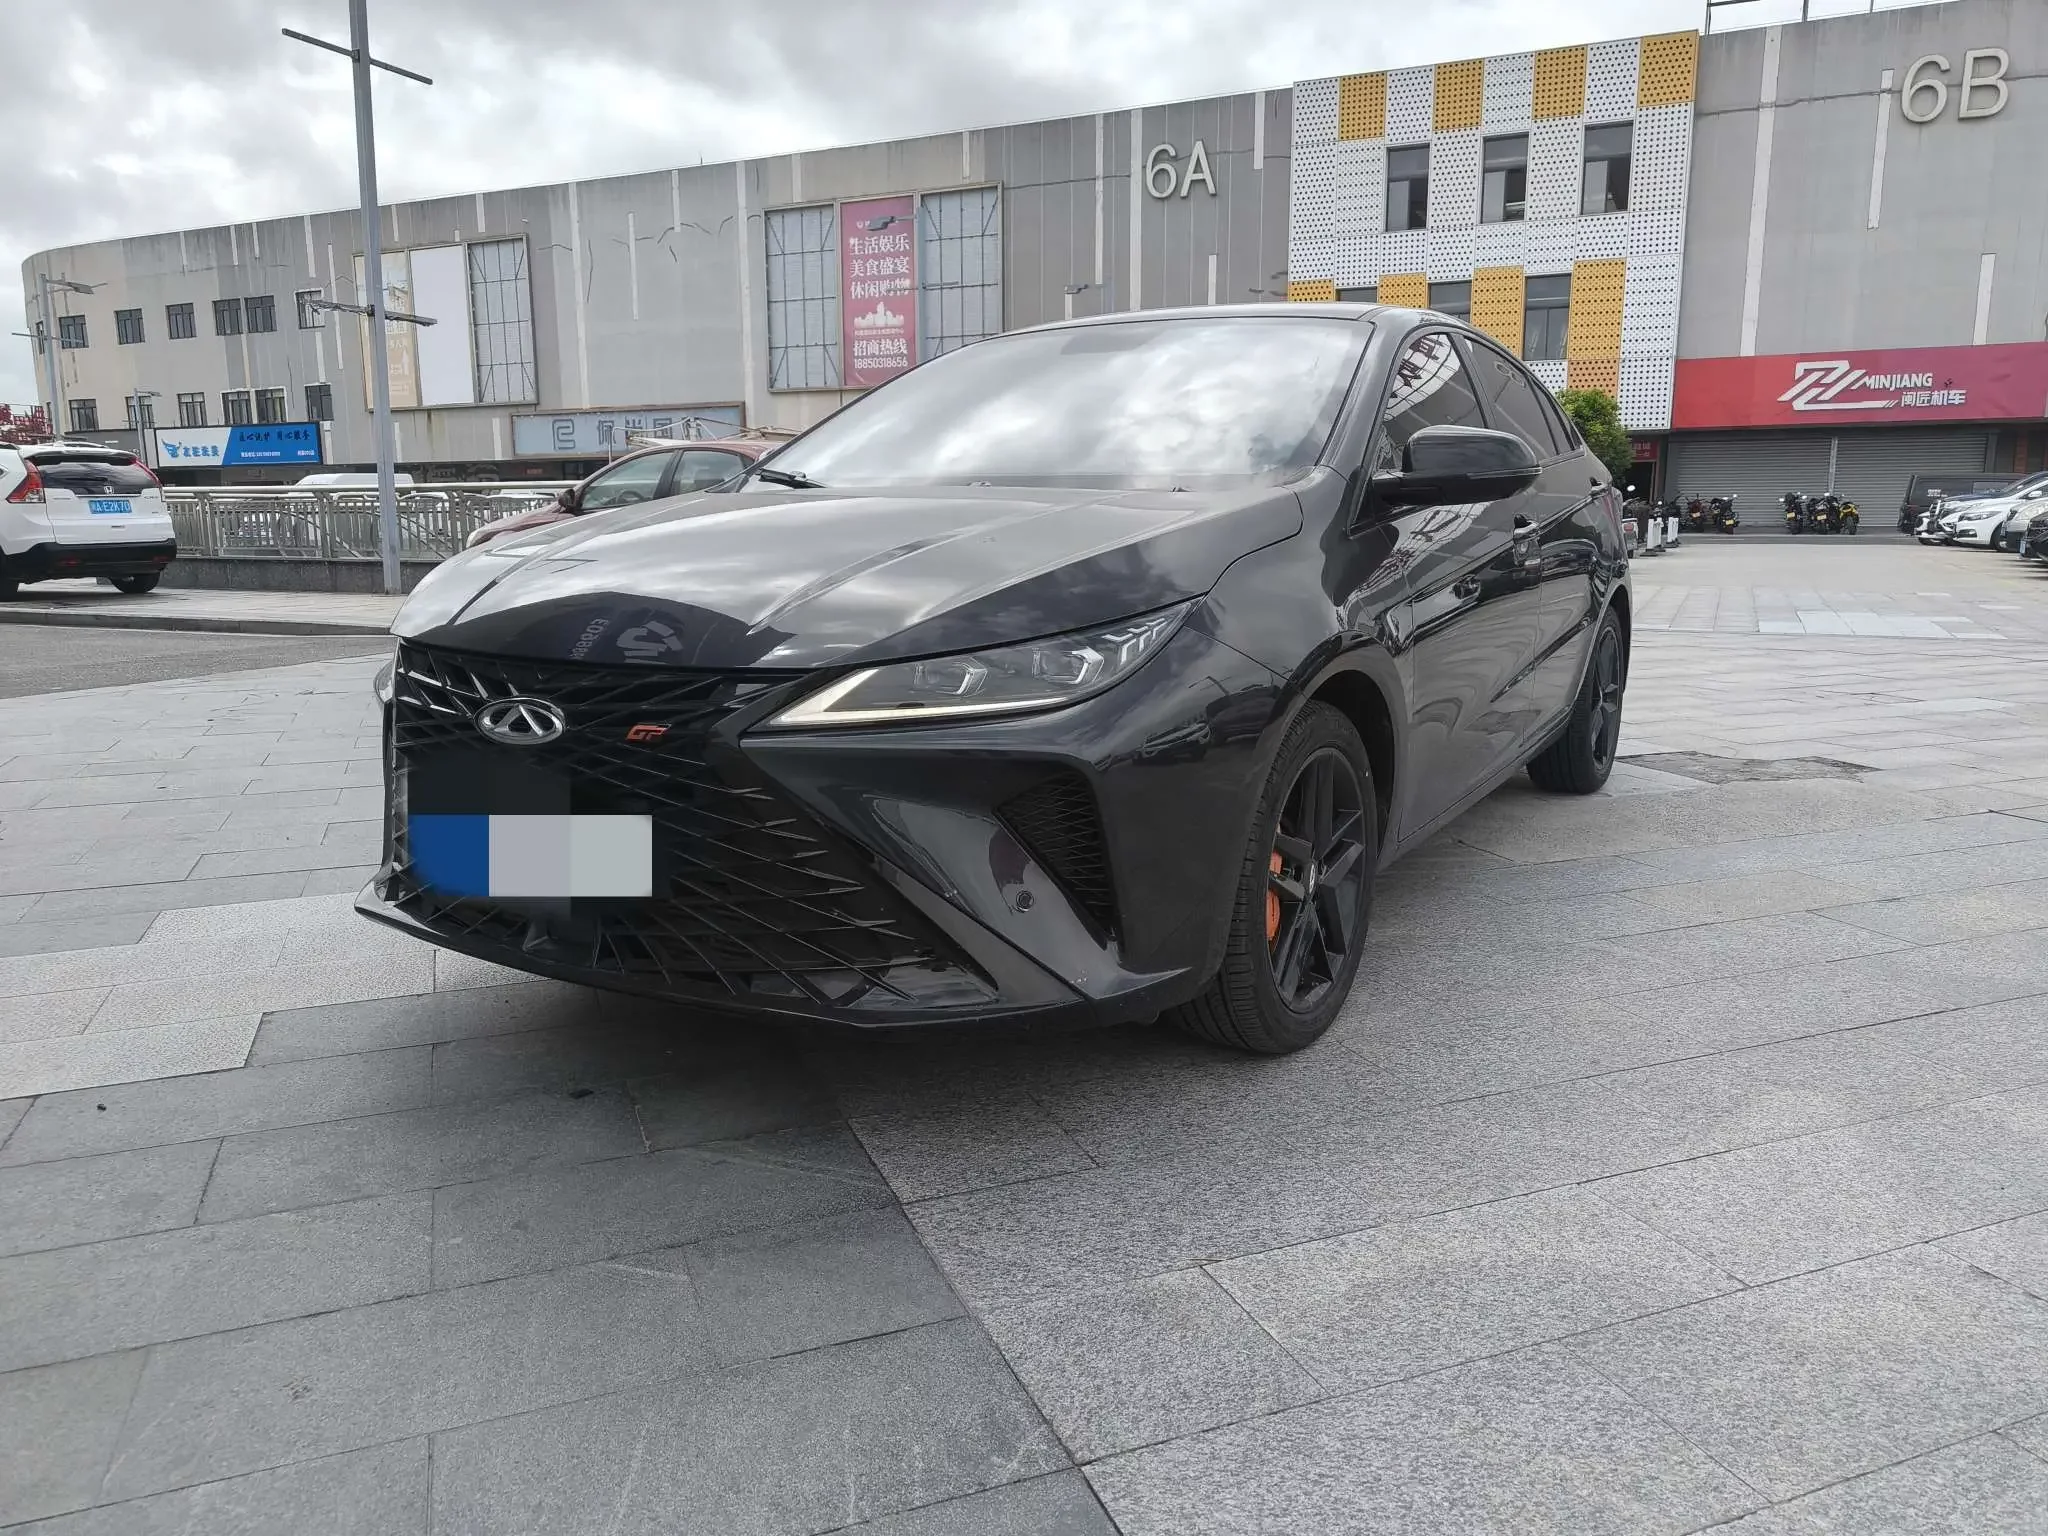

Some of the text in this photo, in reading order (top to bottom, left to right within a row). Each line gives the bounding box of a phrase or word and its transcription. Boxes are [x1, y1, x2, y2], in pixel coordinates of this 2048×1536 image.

[1902, 48, 2009, 122] 6B
[1146, 141, 1216, 198] 6A
[849, 233, 910, 255] 生活娱乐
[849, 256, 910, 278] 美食盛宴
[850, 278, 911, 299] 休闲购物
[853, 338, 908, 356] 招商热线
[854, 357, 909, 369] 18850318656
[1852, 373, 1933, 391] MINJIANG
[1901, 389, 1967, 407] 闽匠机车
